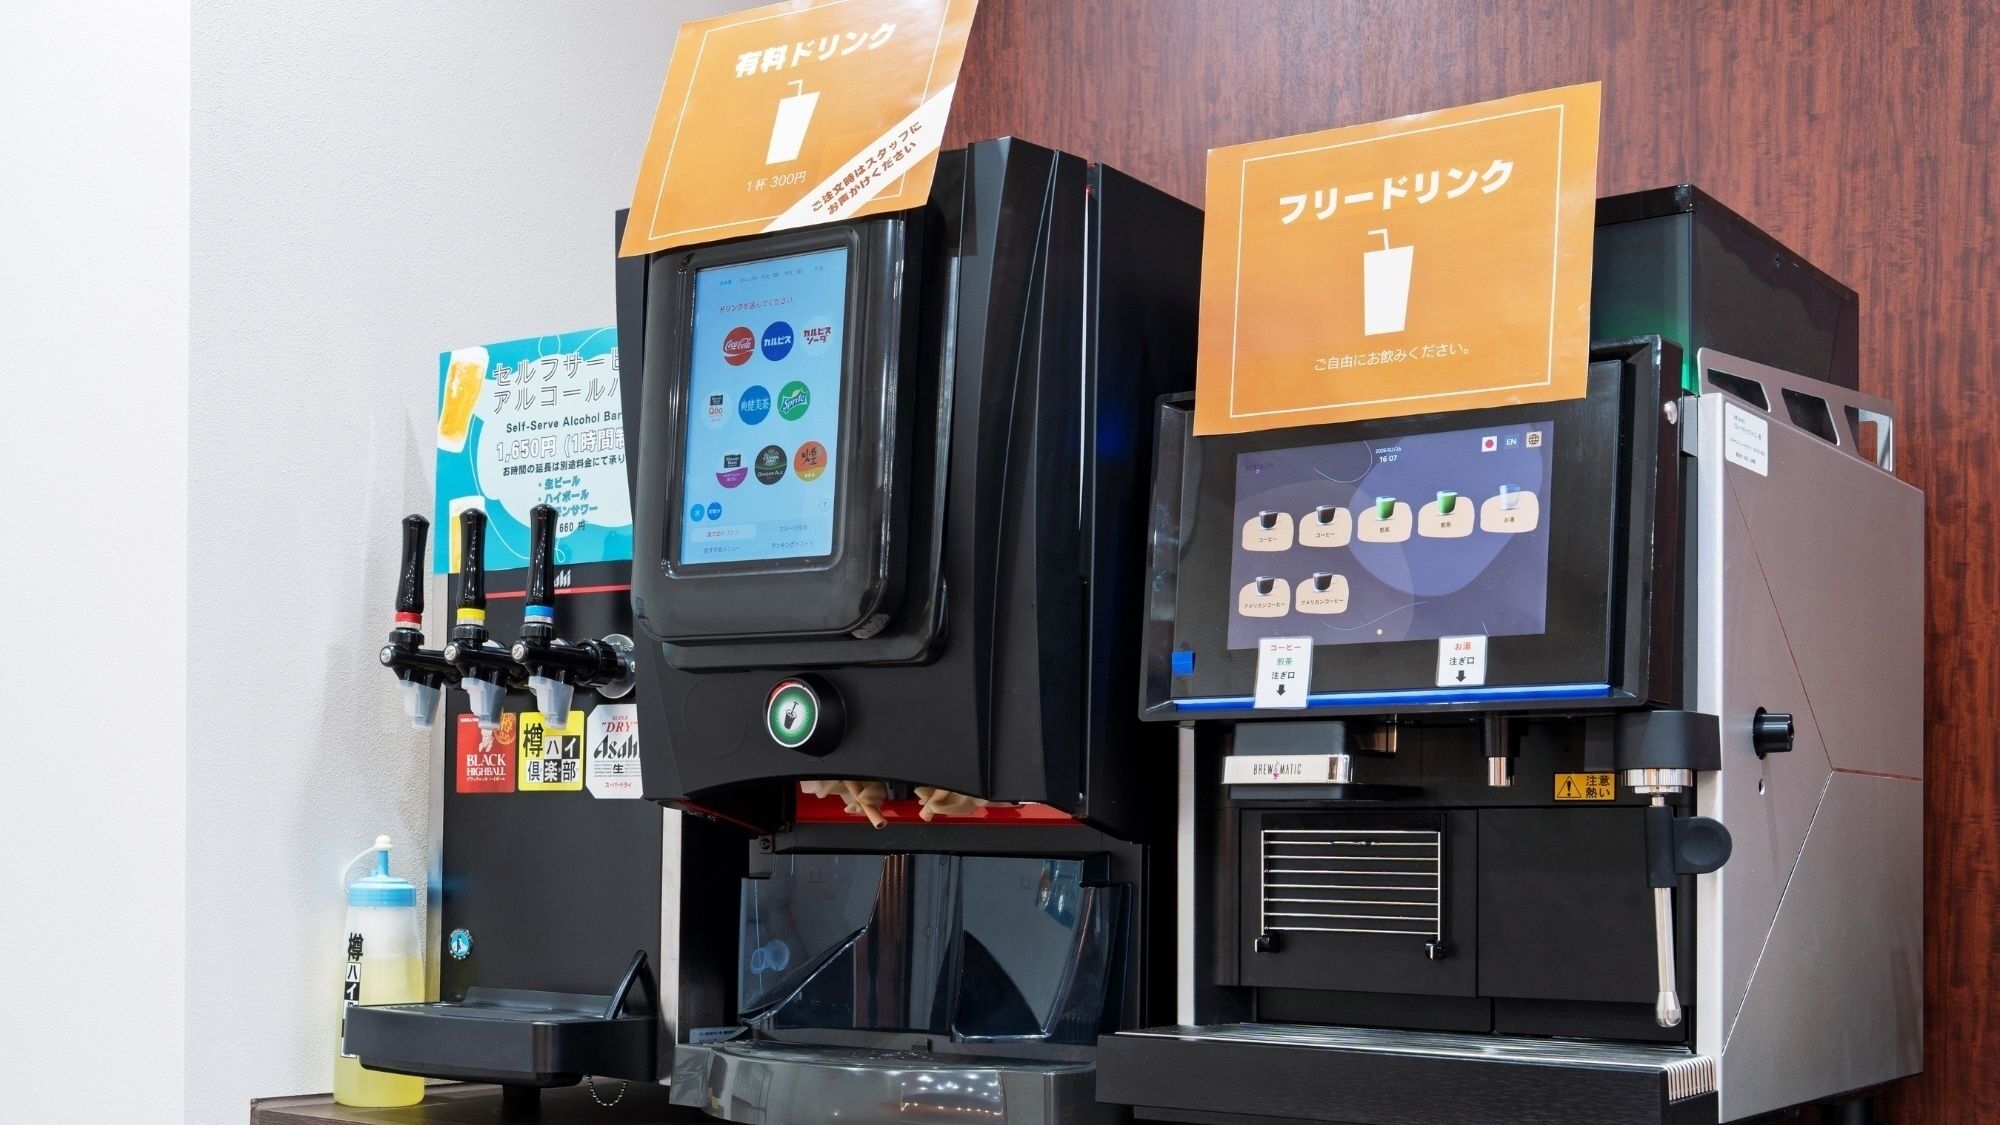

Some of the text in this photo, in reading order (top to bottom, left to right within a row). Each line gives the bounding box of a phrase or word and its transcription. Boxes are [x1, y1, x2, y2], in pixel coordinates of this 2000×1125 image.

[735, 22, 897, 78] 有料ドリンク
[811, 121, 923, 212] ご注文時はスタッフに
[770, 170, 807, 189] 300円
[827, 141, 917, 215] お声がけください
[1279, 159, 1514, 225] フリードリンク
[720, 297, 793, 313] ドリンクを選んでください
[803, 326, 832, 338] カルピス
[764, 335, 792, 347] カルピス
[806, 334, 829, 345] ソーダ
[1314, 343, 1469, 371] ご自由にお飲みください。
[782, 394, 806, 411] Sprite
[708, 406, 724, 415] Qoo
[506, 420, 559, 433] Self-Serve
[562, 412, 600, 427] Alcohol
[496, 435, 558, 462] 1,650円
[1507, 438, 1517, 446] EN
[559, 523, 574, 532] 660
[1455, 641, 1472, 651] お湯
[1449, 656, 1475, 666] 注ぎ口
[1271, 671, 1295, 680] 注ぎ口
[593, 734, 640, 760] Asah
[466, 753, 507, 767] BLACK
[466, 767, 507, 776] HIGHBALL
[527, 760, 577, 782] 倶楽部
[612, 763, 625, 775] 生
[1253, 763, 1302, 776] BREW MATIC
[1585, 775, 1611, 787] 注意
[1585, 787, 1611, 799] 熱い
